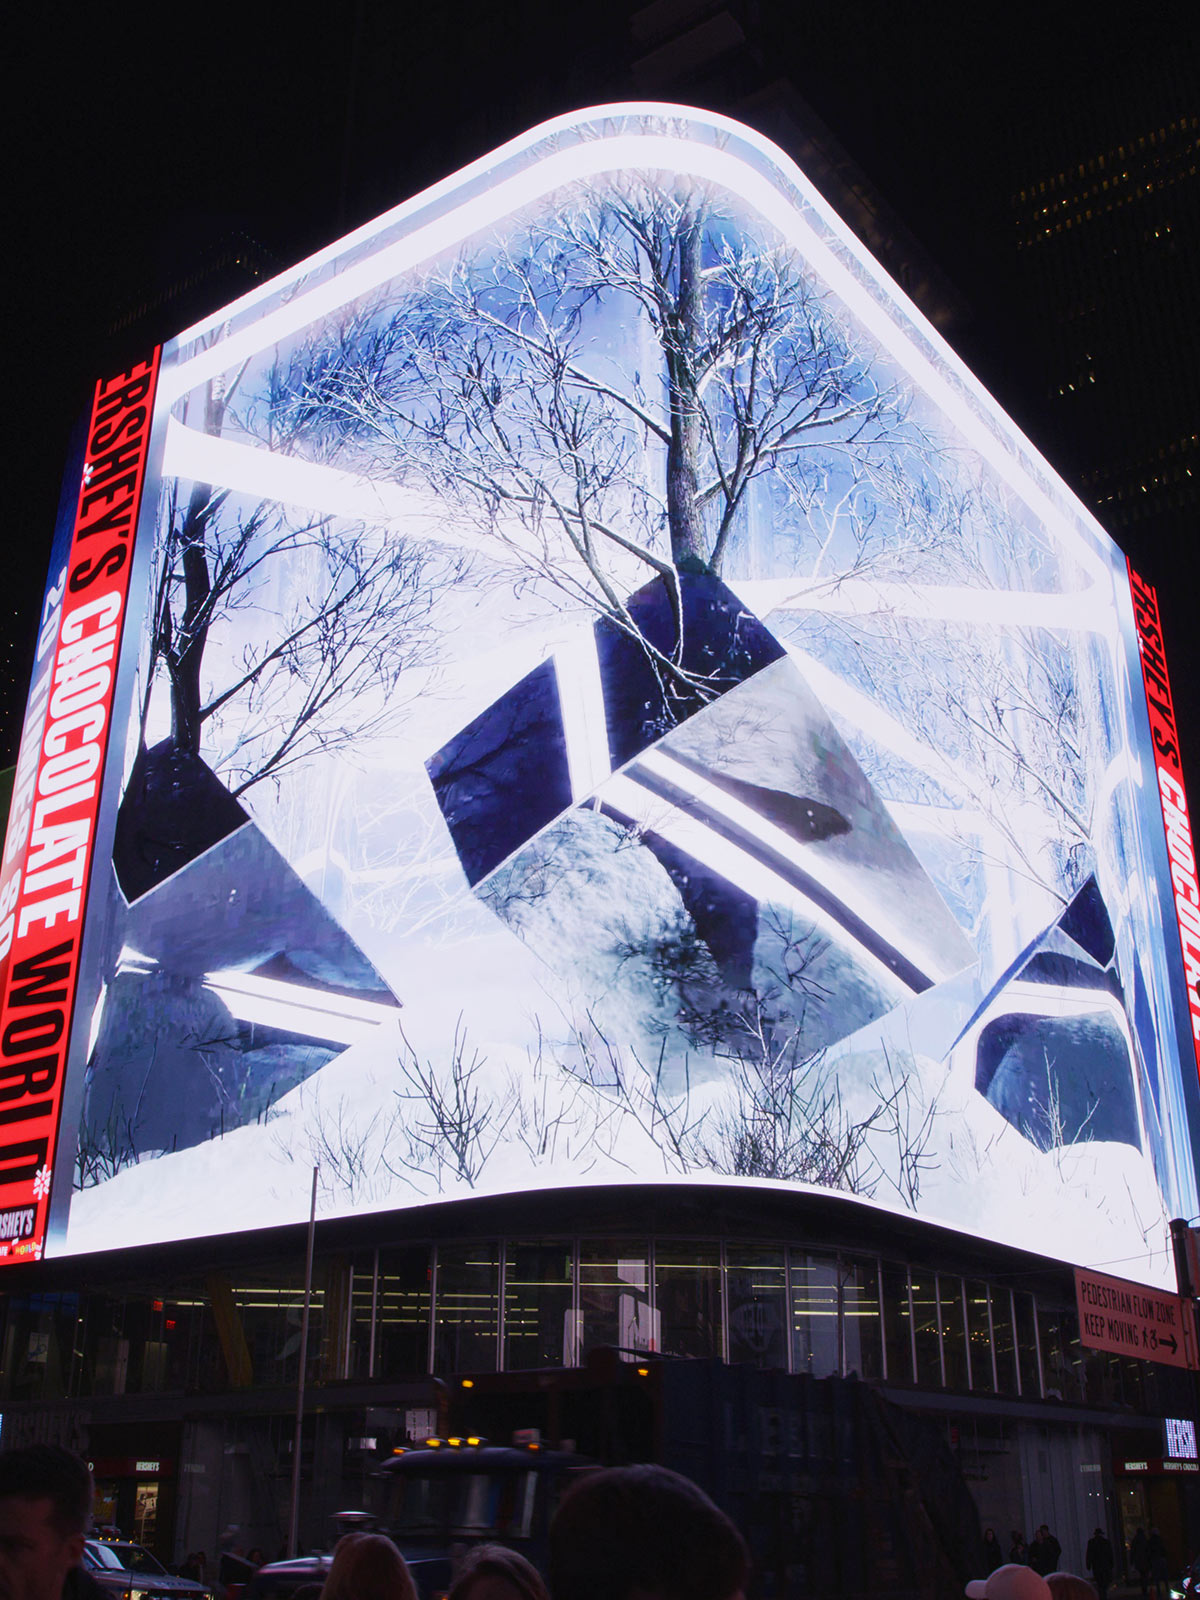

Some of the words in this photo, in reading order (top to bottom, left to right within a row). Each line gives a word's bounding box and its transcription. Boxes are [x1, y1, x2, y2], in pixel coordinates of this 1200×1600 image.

[37, 565, 67, 662] 20
[6, 655, 54, 864] TIMES
[17, 591, 121, 938] CHOCOLATE
[1081, 1281, 1132, 1315] PEDESTRIAN
[1133, 1295, 1154, 1319] FLOW
[1155, 1301, 1176, 1326] ZONE
[1084, 1312, 1105, 1338] KEEP
[1107, 1317, 1139, 1346] MOVING
